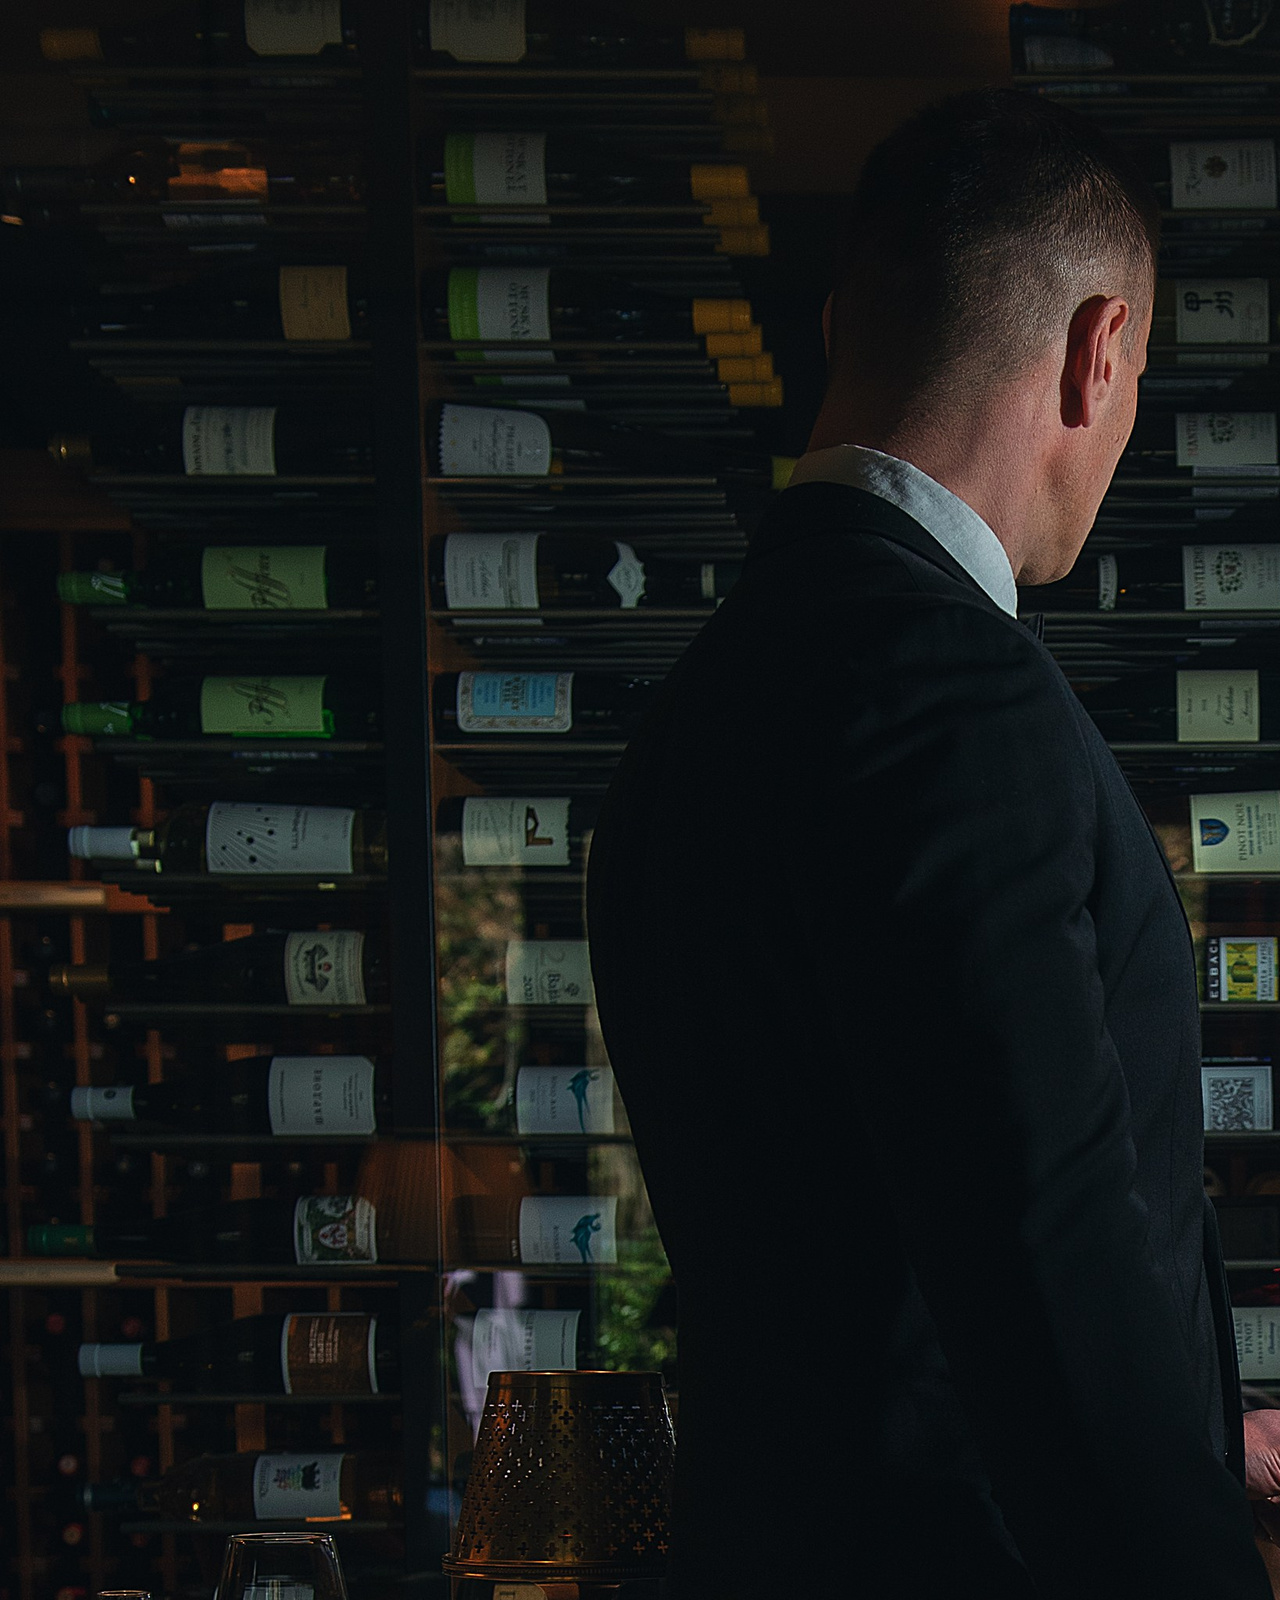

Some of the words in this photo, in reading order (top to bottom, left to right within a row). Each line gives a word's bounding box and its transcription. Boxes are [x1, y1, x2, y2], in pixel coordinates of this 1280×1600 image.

[1184, 291, 1235, 319] 甲州
[1235, 802, 1247, 827] NOIR
[1236, 830, 1249, 861] PINOT
[1209, 938, 1219, 998] ELBACH
[1244, 1322, 1254, 1354] PINOT
